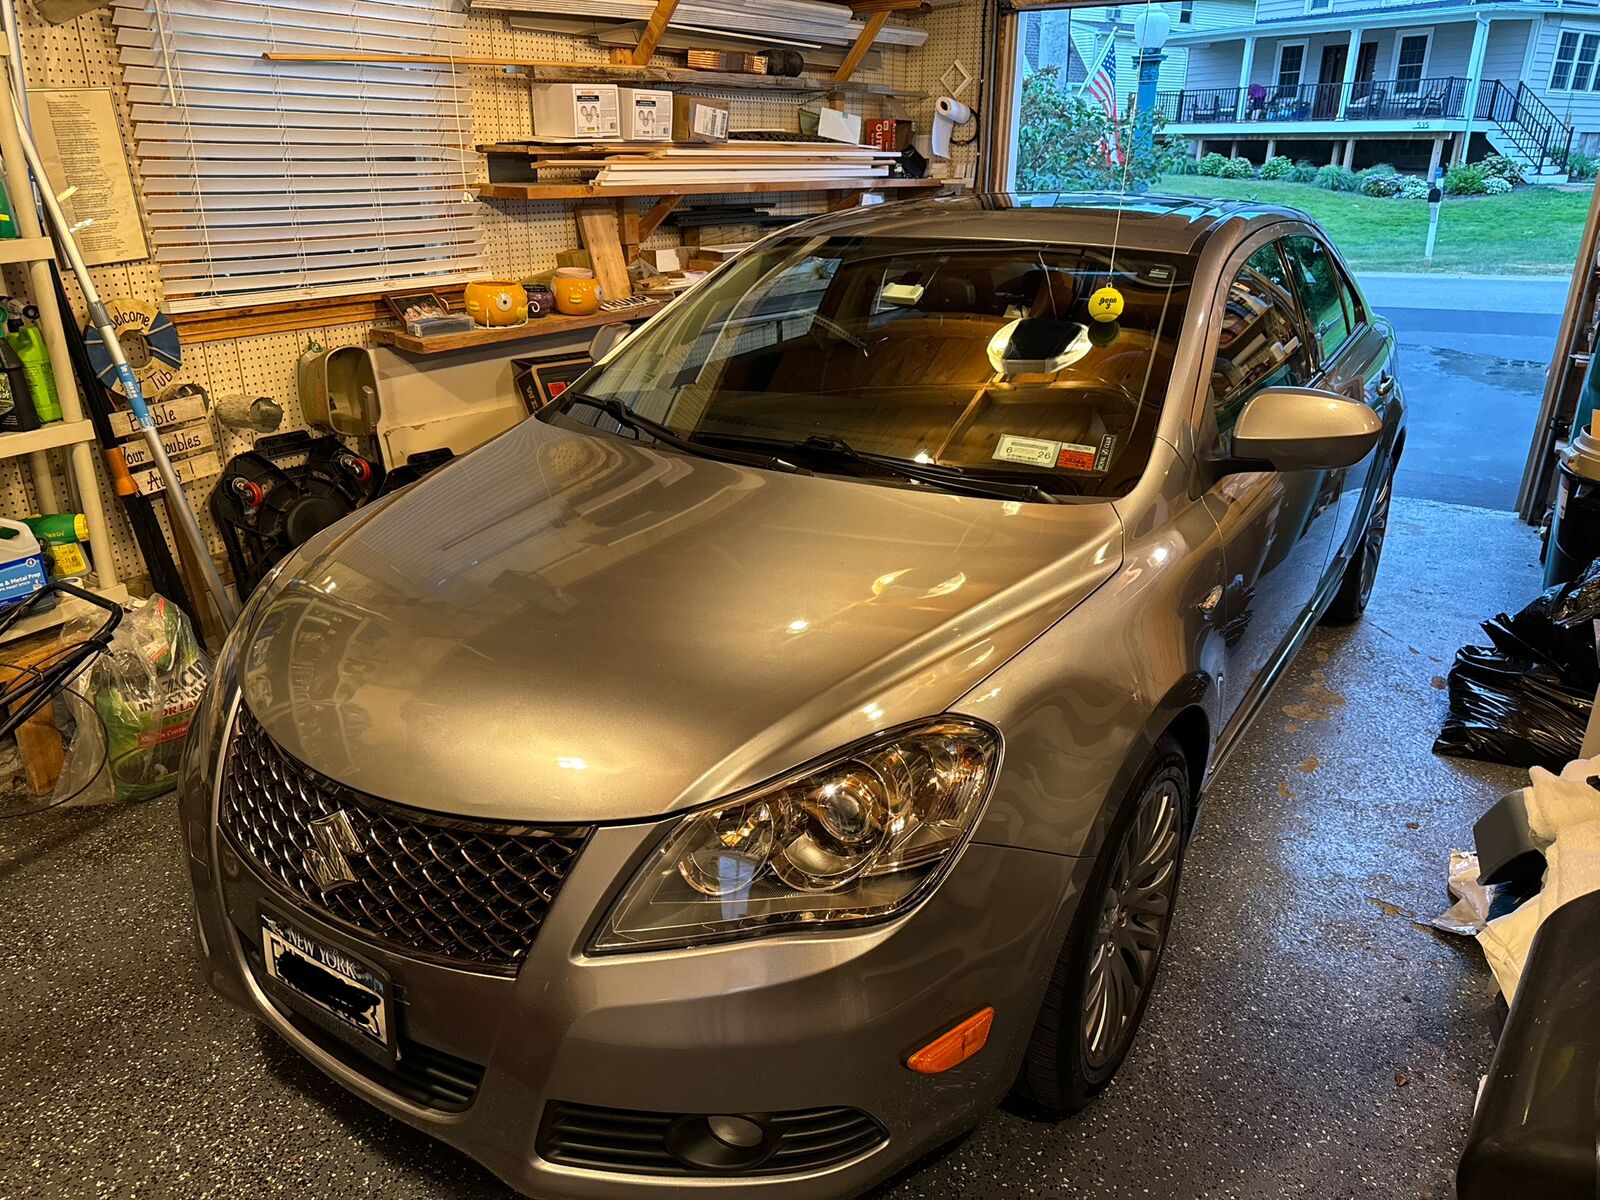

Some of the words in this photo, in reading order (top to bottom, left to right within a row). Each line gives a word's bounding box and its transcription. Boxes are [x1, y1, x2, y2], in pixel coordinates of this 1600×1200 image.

[146, 368, 173, 391] Tub
[1006, 446, 1013, 455] 6
[1037, 450, 1052, 460] 26
[10, 573, 28, 585] Metal
[286, 929, 315, 957] NEW
[319, 946, 357, 980] YORK
